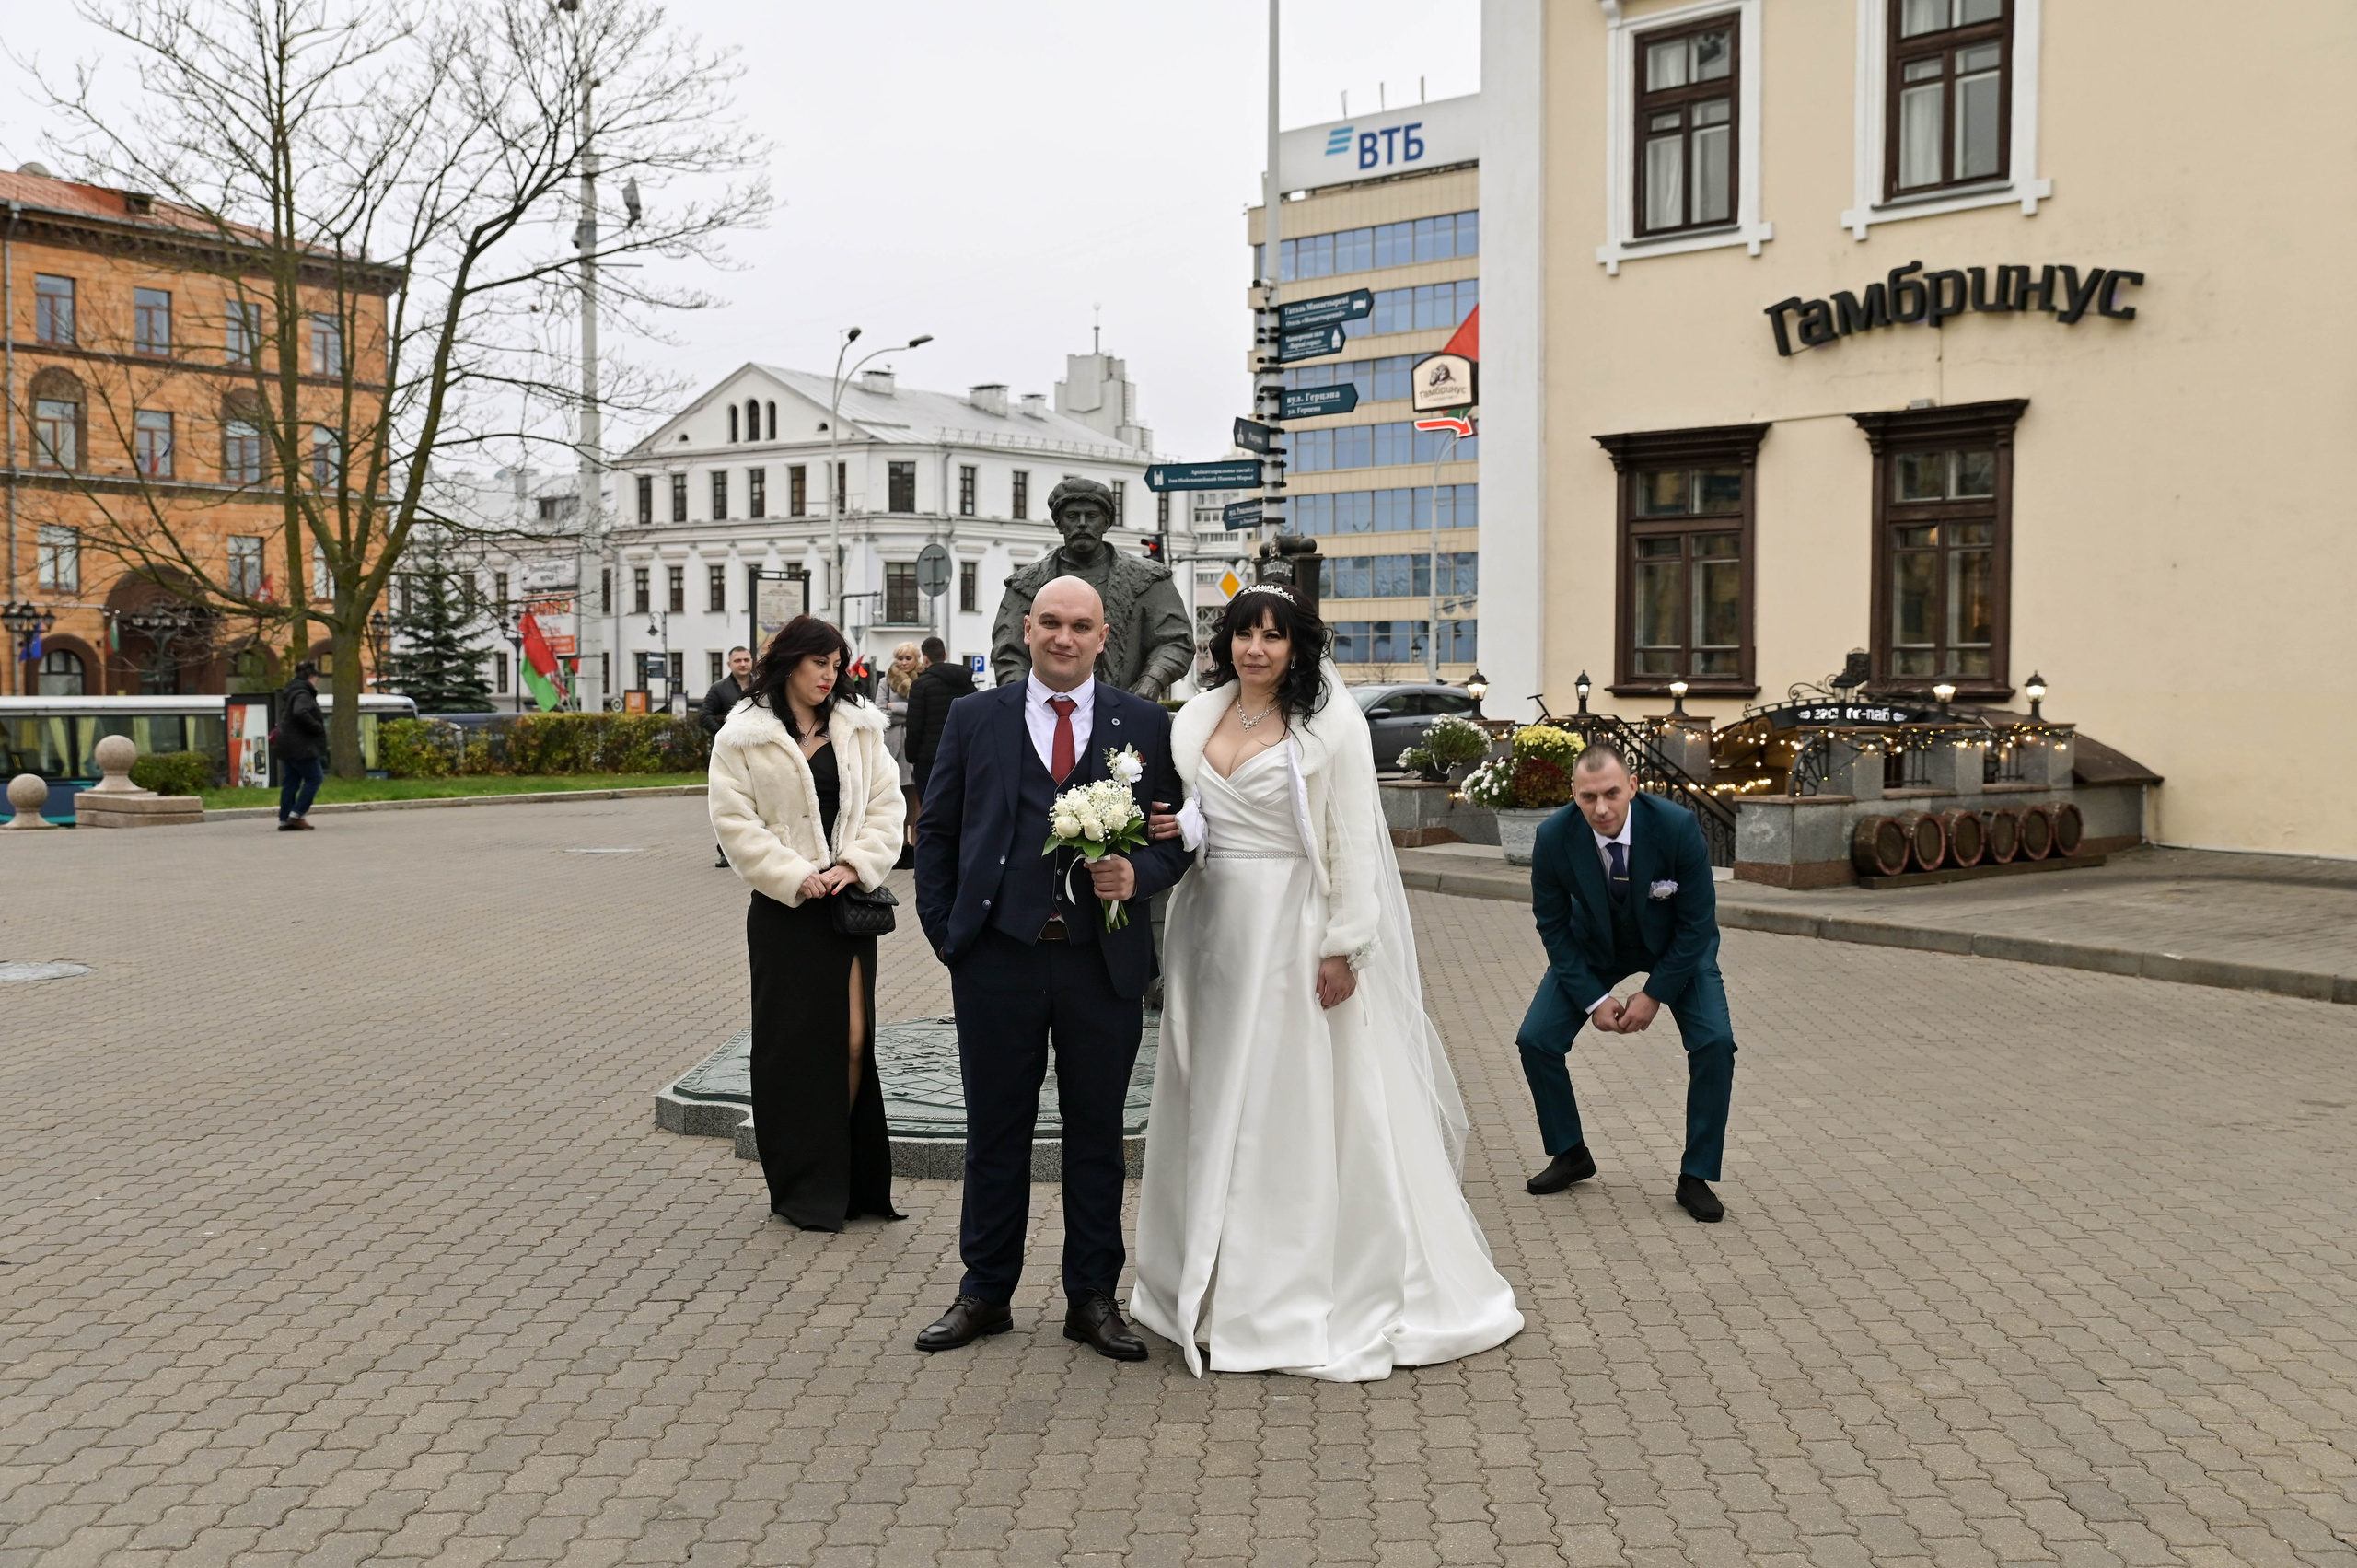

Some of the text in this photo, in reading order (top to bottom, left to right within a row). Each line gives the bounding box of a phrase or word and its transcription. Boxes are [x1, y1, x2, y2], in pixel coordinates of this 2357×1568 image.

[1359, 122, 1425, 170] ВТБ
[1764, 260, 2144, 357] Гамбринус
[1286, 391, 1341, 405] вул. Герцэна
[1419, 386, 1467, 400] Гамбринус
[974, 656, 983, 671] P
